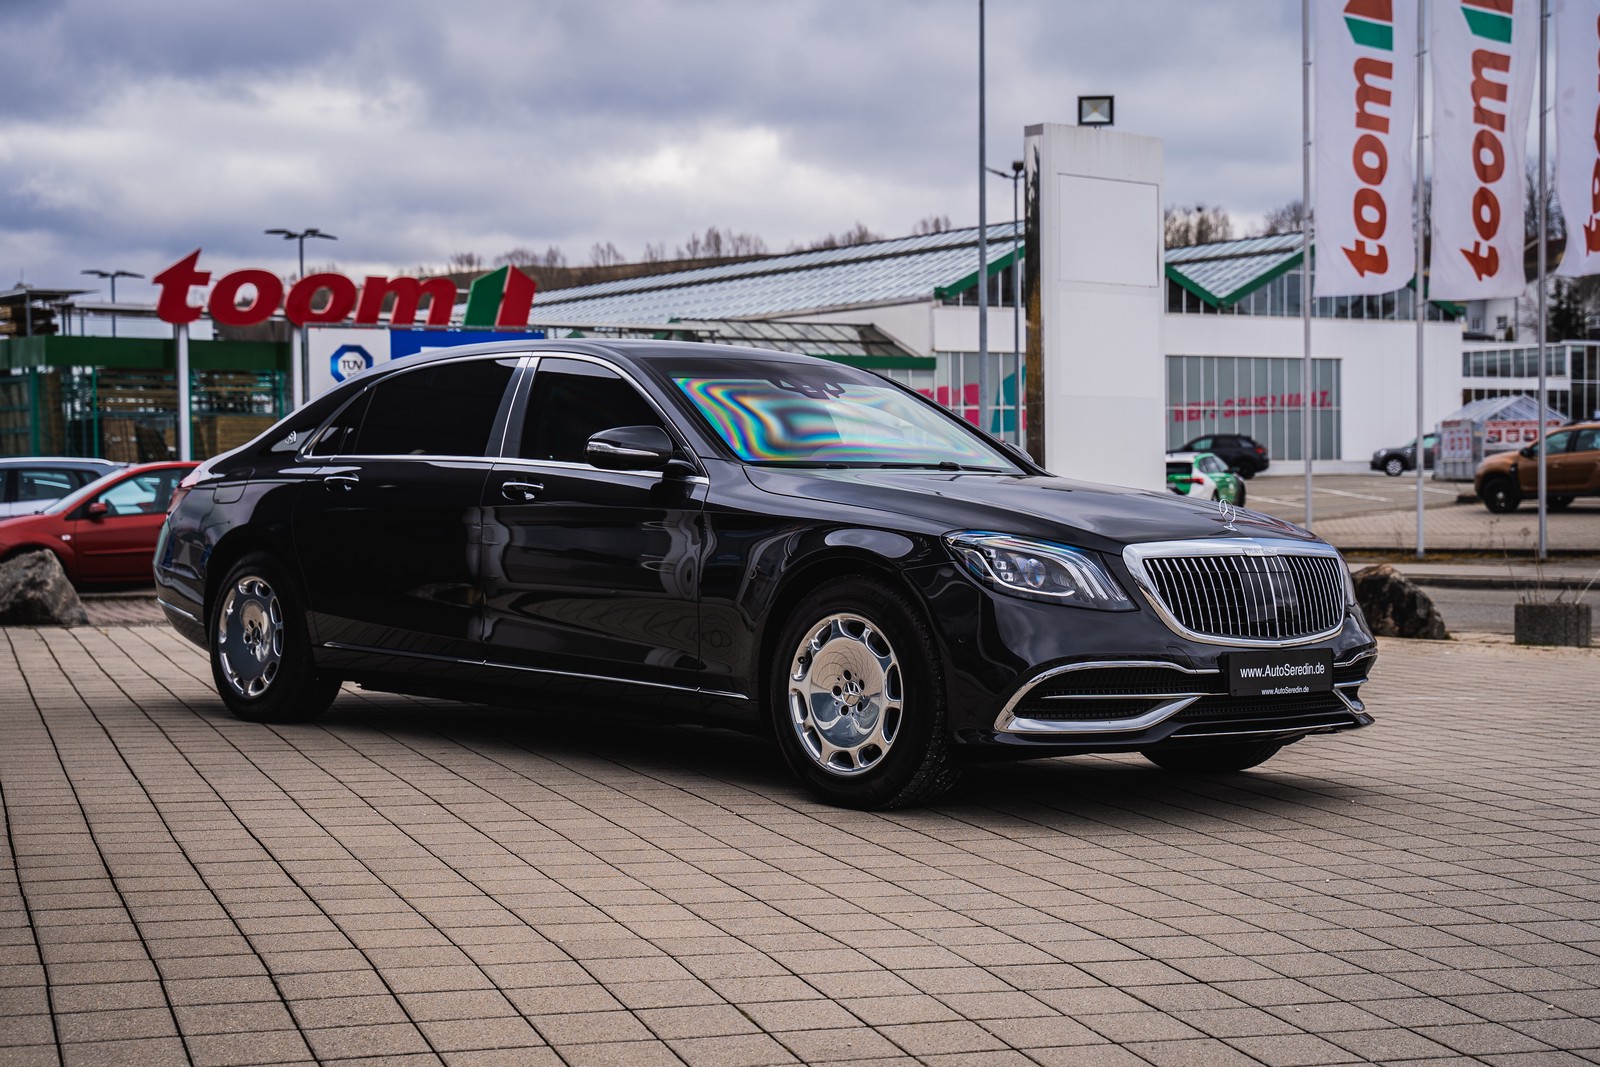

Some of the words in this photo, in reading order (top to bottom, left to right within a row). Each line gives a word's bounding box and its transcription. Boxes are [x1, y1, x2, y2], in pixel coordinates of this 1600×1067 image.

[1341, 57, 1393, 278] toom
[1459, 48, 1511, 282] toom
[153, 247, 458, 327] toom
[1240, 662, 1325, 678] www.AutoSeredin.de
[1261, 685, 1310, 695] www.AutoSeredin.de
